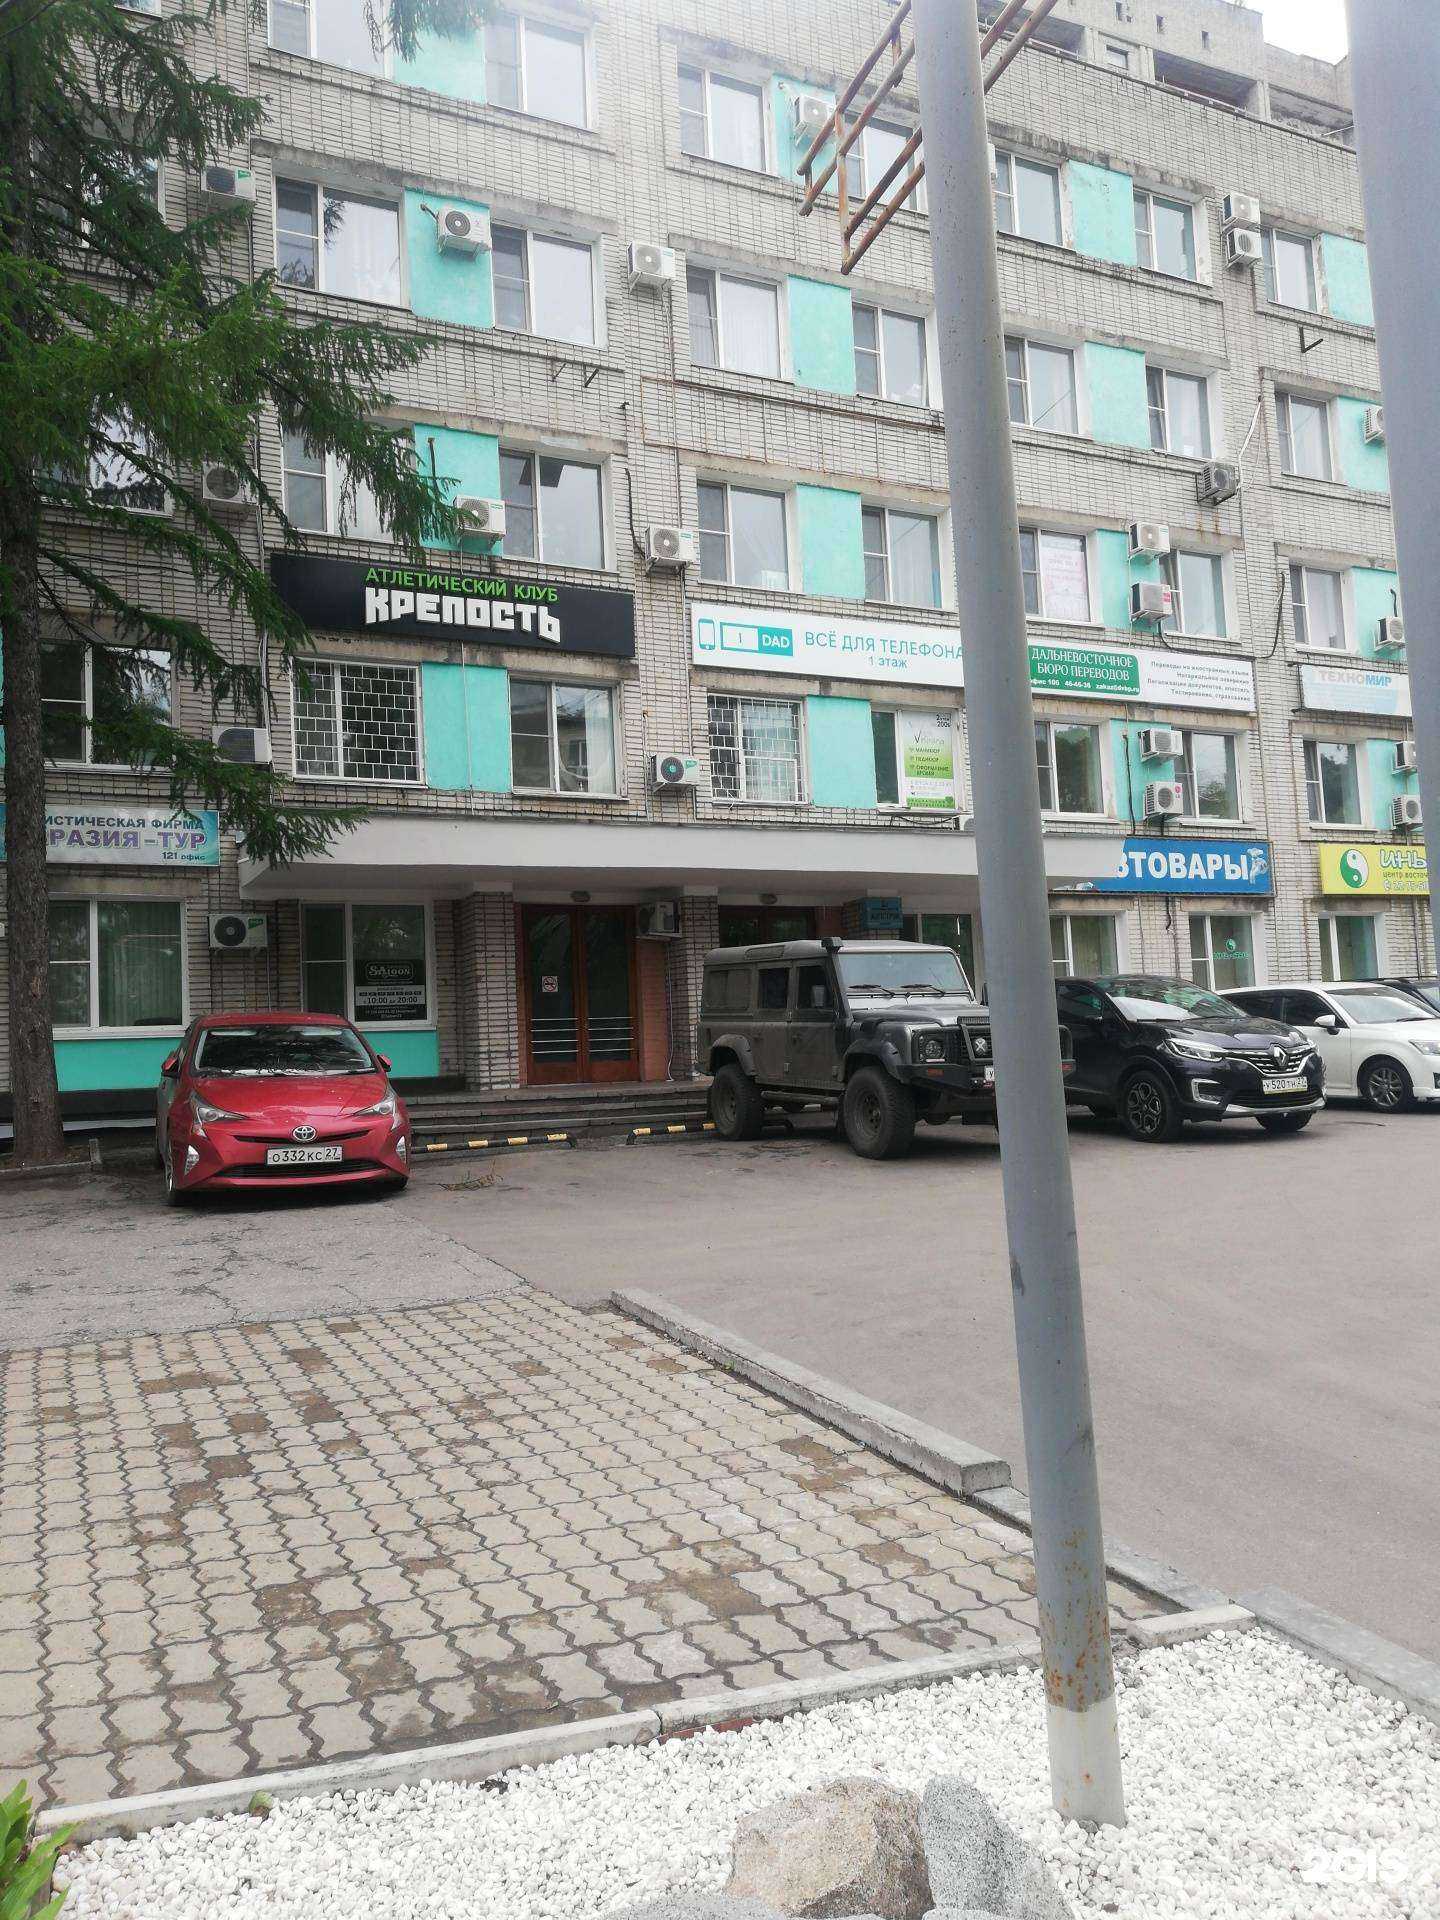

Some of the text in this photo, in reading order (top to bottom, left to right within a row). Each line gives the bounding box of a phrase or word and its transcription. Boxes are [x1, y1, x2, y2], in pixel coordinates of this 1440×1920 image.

[365, 567, 558, 602] АТЛЕТИЧЕСКИЙ КЛУБ
[365, 586, 561, 644] КРЕПОСТЬ
[762, 634, 790, 649] DAD
[805, 630, 964, 659] ВСЁ ДЛЯ ТЕЛЕФОНА
[869, 656, 908, 669] 1 этаж
[1031, 648, 1134, 668] ДАЛЬНЕВОСТОЧНОЕ
[1037, 663, 1130, 681] БЮРО ПЕРЕВОДОВ
[1320, 670, 1392, 687] ТЕХНОМИР
[45, 815, 205, 830] ИСТИЧЕСКАЯ ФИРМА
[162, 851, 178, 861] 121
[368, 996, 388, 1004] 10:00
